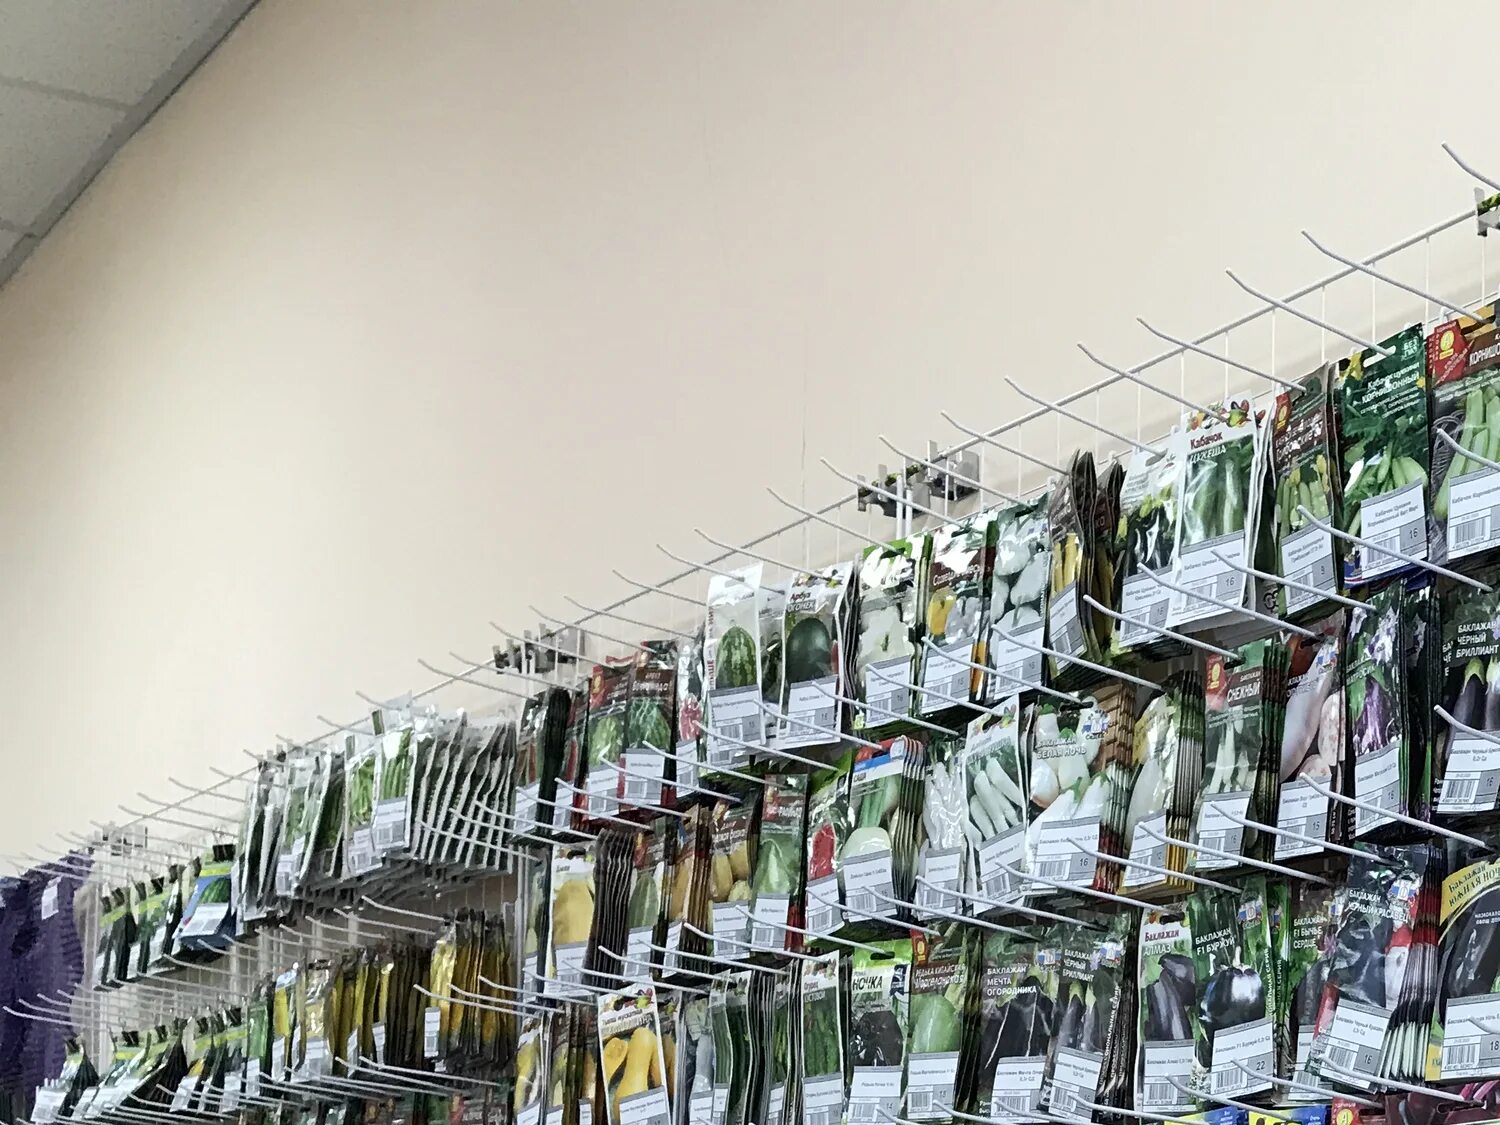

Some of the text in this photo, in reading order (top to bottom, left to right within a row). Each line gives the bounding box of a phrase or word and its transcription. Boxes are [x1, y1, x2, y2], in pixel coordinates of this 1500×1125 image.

[852, 977, 883, 991] НОЧКА
[987, 977, 1012, 986] МЕЧТА
[987, 986, 1036, 995] ОГОРОДНИКА
